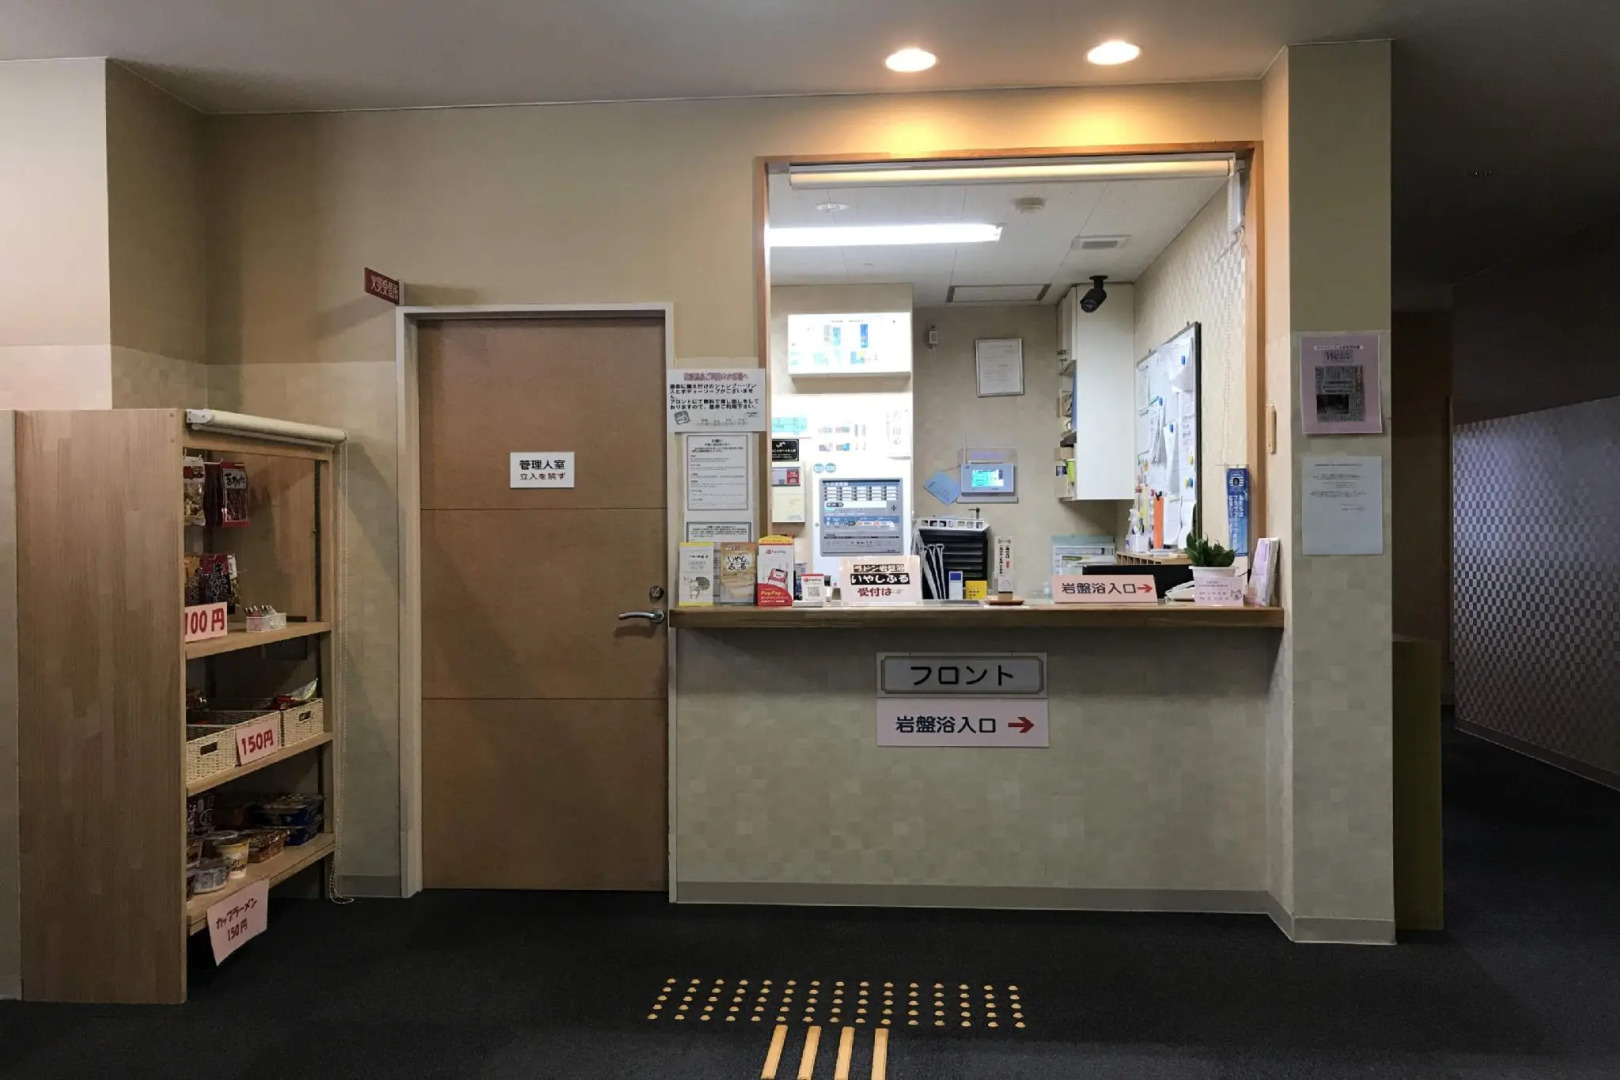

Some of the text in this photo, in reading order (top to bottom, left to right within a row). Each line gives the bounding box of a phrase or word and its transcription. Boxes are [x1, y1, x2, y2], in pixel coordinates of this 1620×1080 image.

[519, 459, 566, 471] 管理人室
[1061, 582, 1137, 594] 岩盤浴入口
[185, 607, 225, 636] 100円
[910, 664, 1014, 686] フロント
[895, 715, 997, 734] 岩盤浴入口
[241, 729, 274, 755] 150円
[227, 917, 248, 941] 150円
